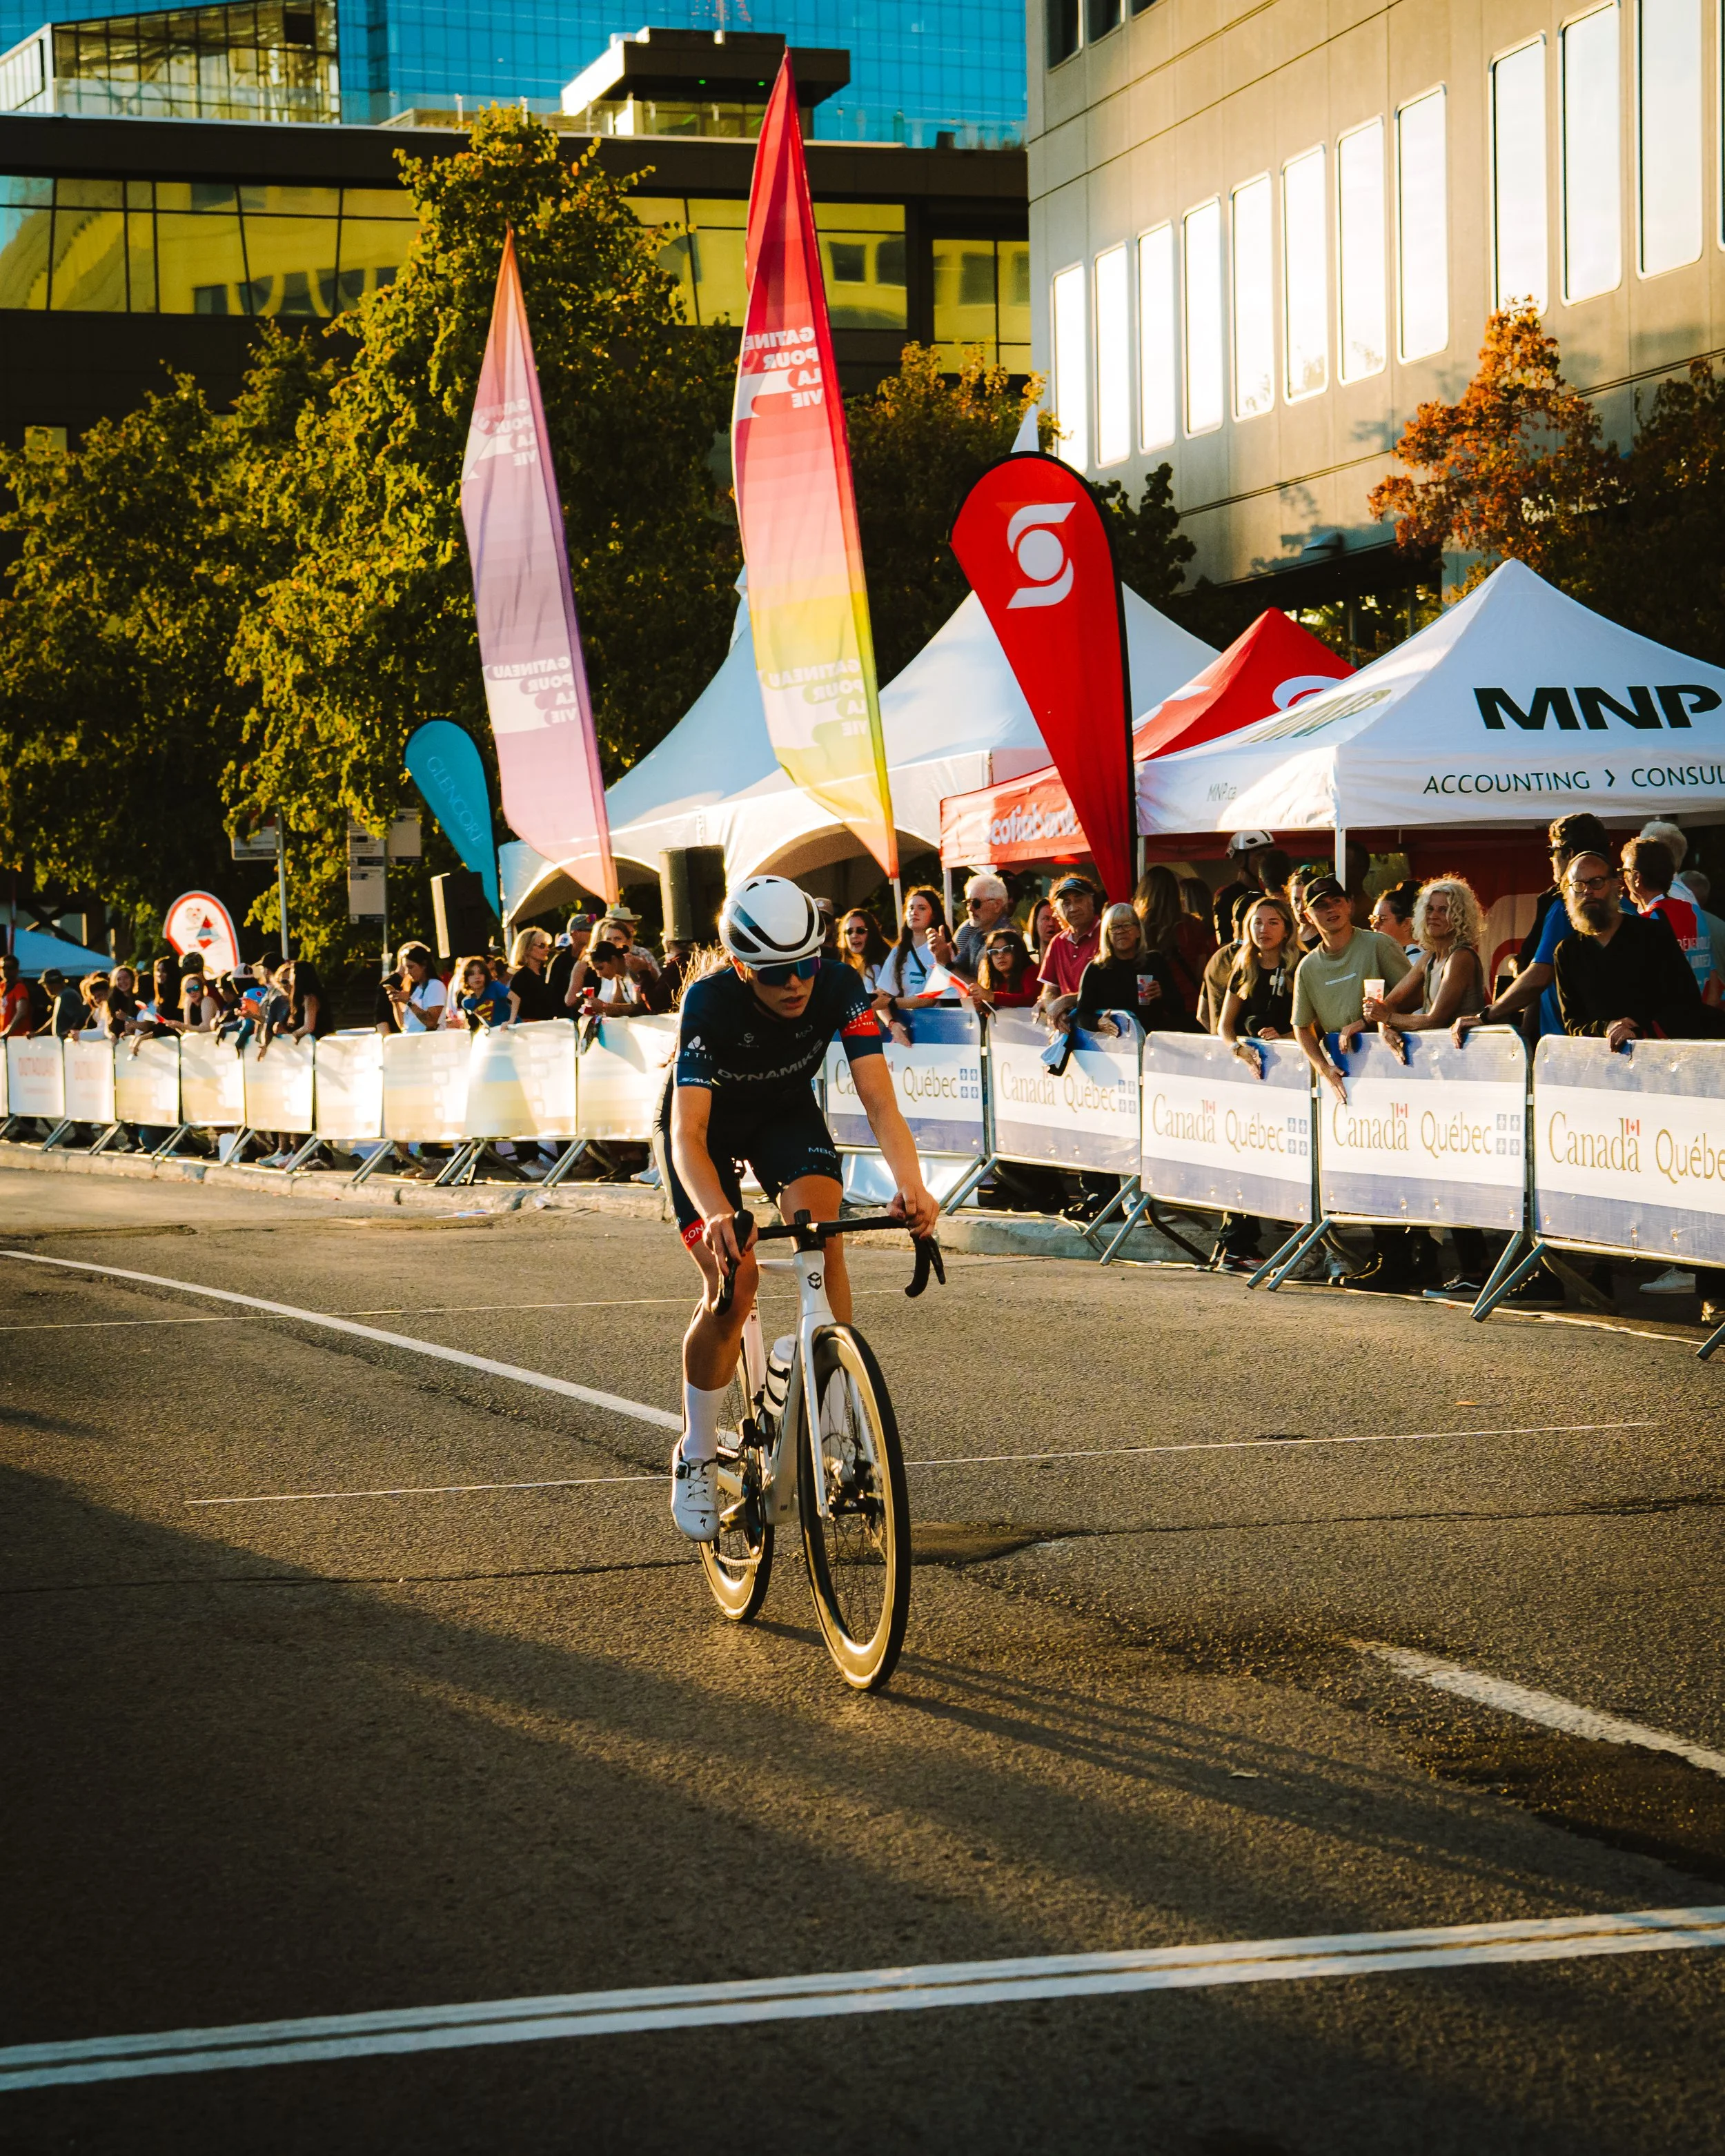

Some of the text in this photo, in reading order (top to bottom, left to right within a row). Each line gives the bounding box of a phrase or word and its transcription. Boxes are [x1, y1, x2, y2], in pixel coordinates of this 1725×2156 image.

[1473, 684, 1723, 731] MNP
[426, 756, 483, 847] GLENCORE
[1207, 782, 1237, 802] MNP.ca
[1423, 765, 1725, 794] ACCOUNTING CONSUL
[903, 1066, 958, 1102] Québec
[1001, 1062, 1116, 1113] Canada Québec
[1153, 1094, 1285, 1153] Canada Québec
[1333, 1102, 1492, 1159] Canada Québec
[808, 1147, 836, 1159] MBO
[1548, 1111, 1725, 1185] Canada Québe
[684, 1224, 705, 1243] CON
